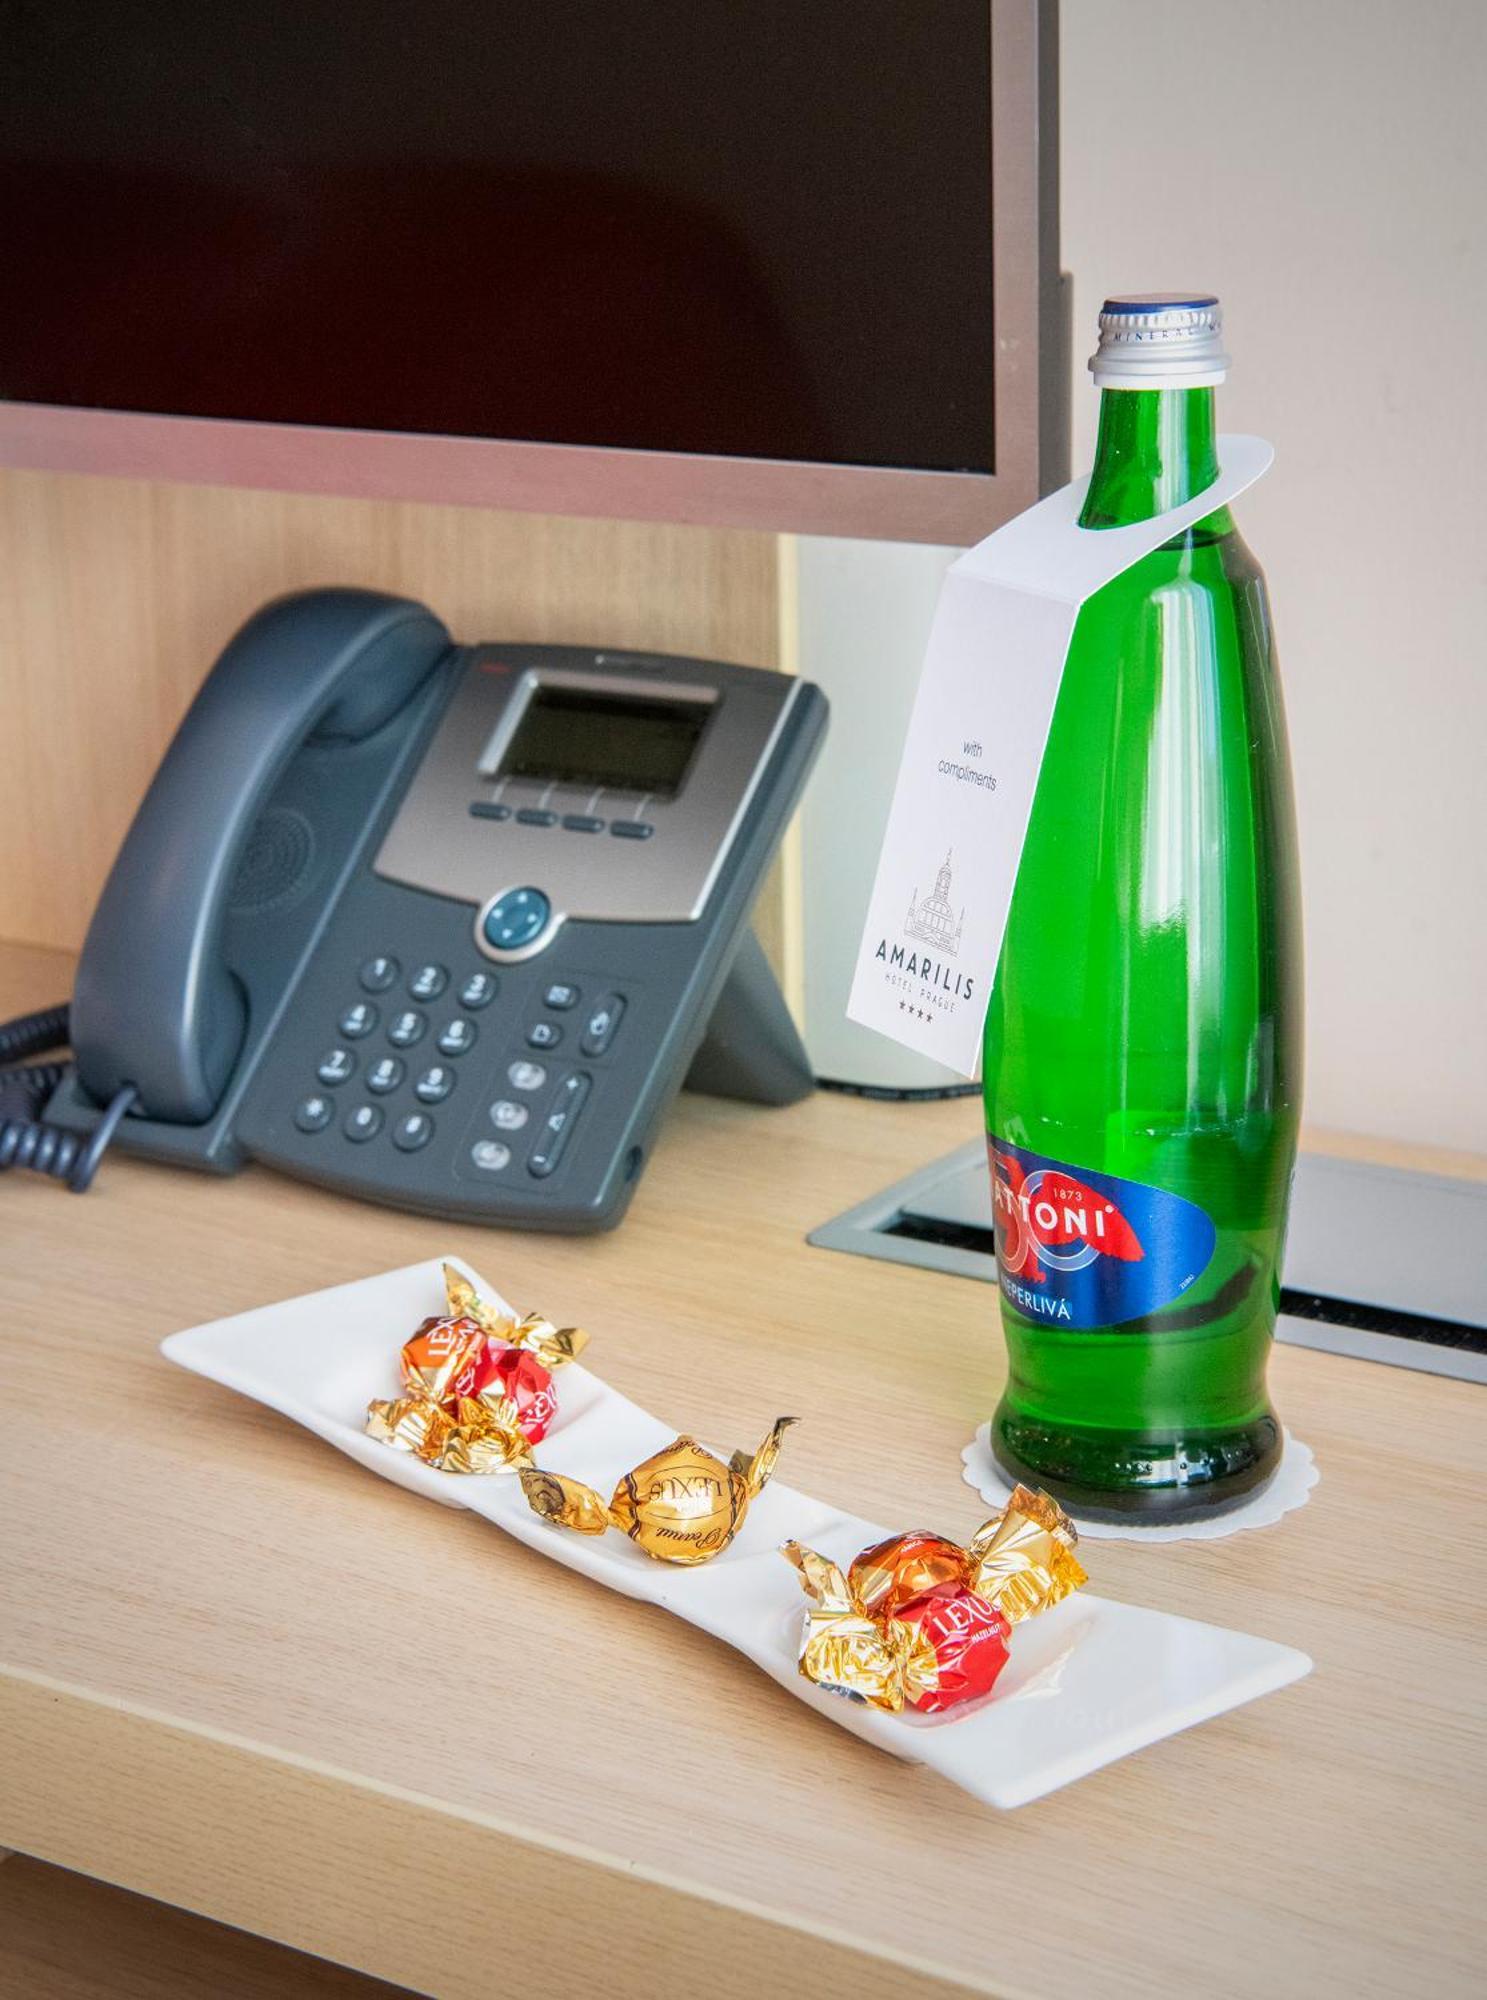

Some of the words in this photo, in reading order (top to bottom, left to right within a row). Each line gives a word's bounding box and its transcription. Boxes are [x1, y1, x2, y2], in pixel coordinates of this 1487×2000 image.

[962, 739, 983, 757] with
[938, 759, 997, 791] compliments
[875, 939, 975, 1001] AMARILIS
[1053, 1187, 1083, 1202] 1873
[994, 1180, 1105, 1237] ATTONI
[648, 1476, 723, 1501] LEXUS
[655, 1526, 722, 1549] Peanut
